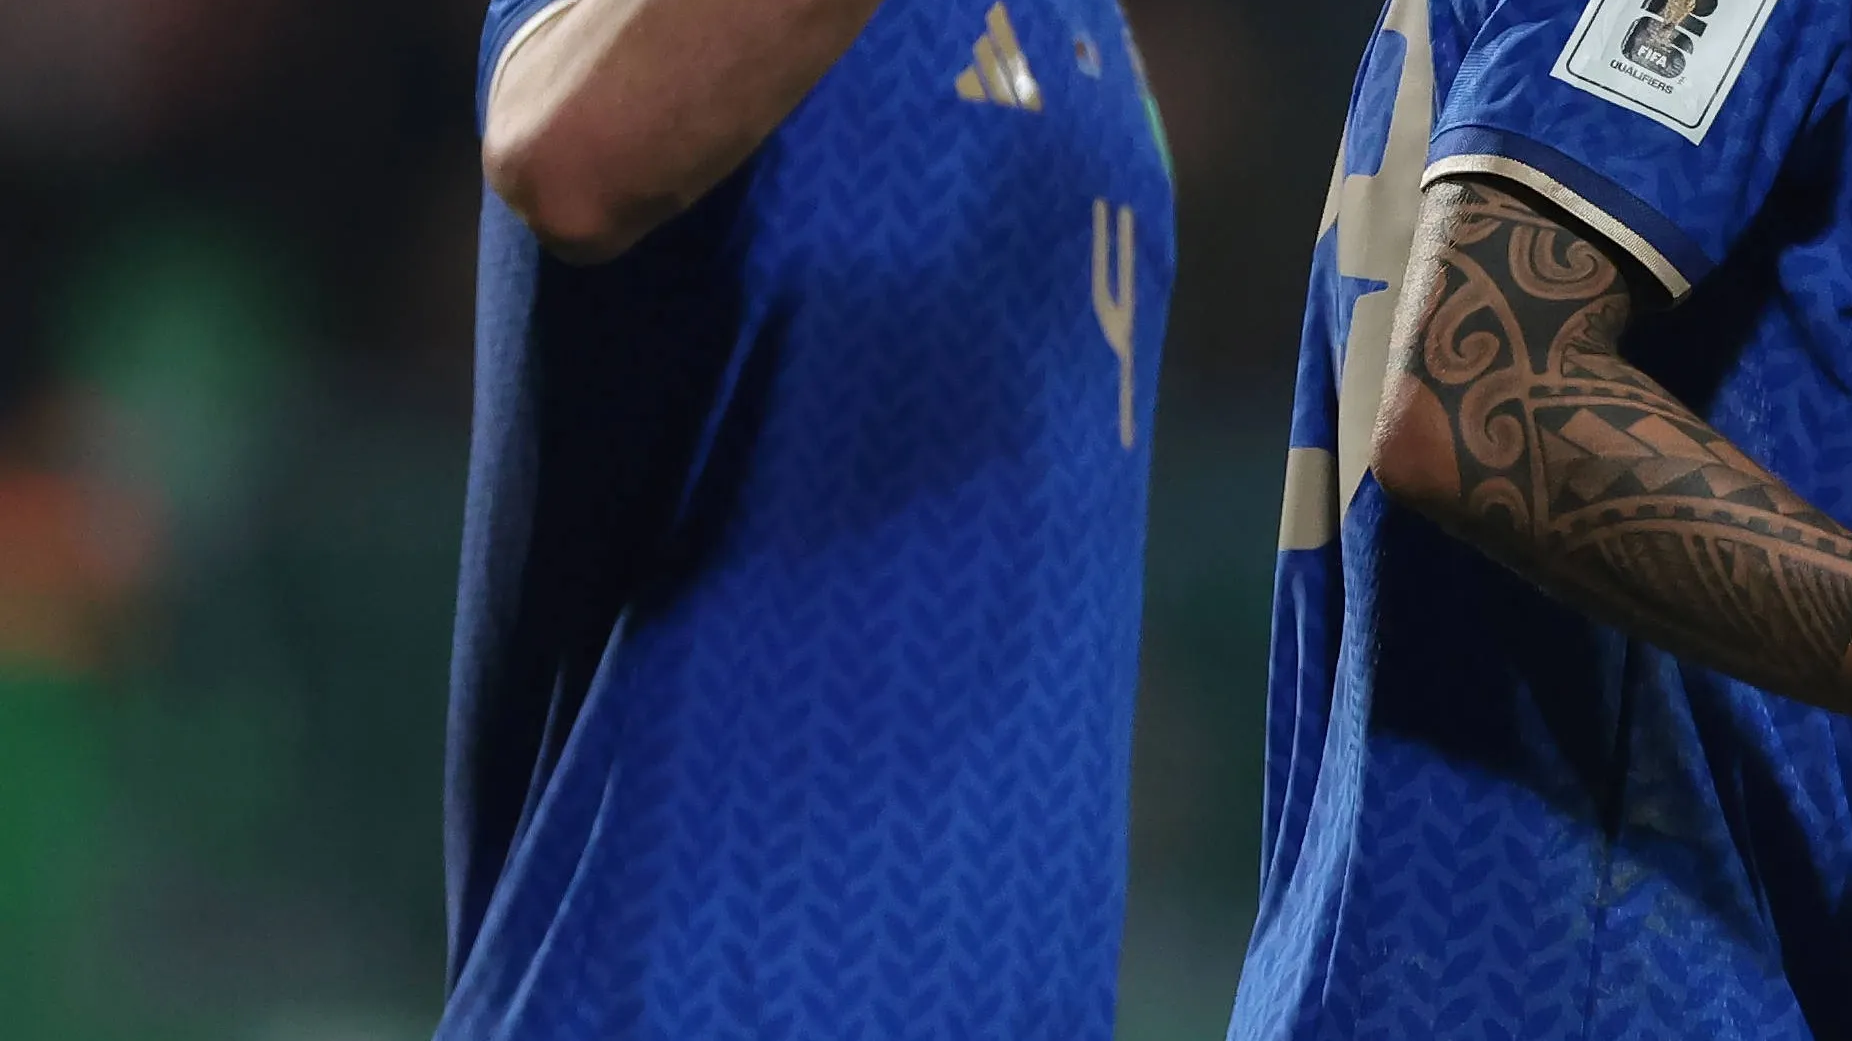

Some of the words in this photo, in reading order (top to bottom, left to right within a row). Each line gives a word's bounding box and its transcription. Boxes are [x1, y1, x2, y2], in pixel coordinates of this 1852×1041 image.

[1637, 45, 1668, 68] FIFA
[1609, 59, 1675, 95] QUALIFIERS
[1091, 197, 1136, 449] 4
